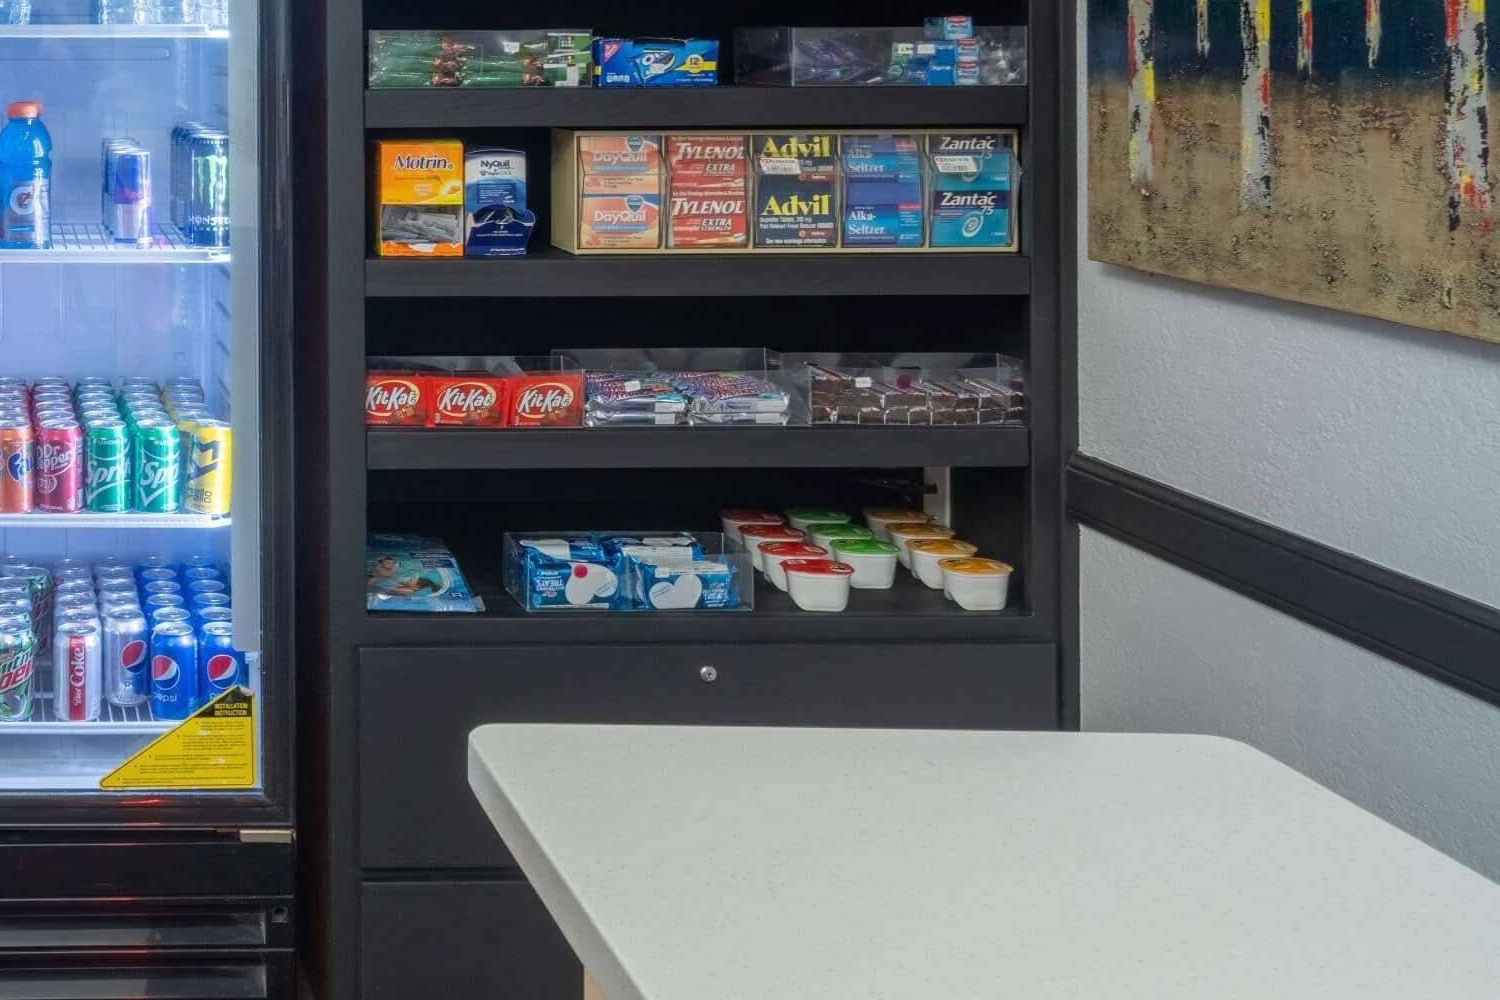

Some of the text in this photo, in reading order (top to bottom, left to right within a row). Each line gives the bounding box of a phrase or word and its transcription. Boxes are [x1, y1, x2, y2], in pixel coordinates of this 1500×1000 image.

[690, 57, 700, 66] 12
[760, 136, 831, 158] Advil
[940, 136, 996, 150] Zantac
[675, 143, 745, 161] TYLENOL
[394, 154, 448, 170] Motrin
[480, 160, 510, 169] NyQuil
[761, 194, 831, 216] Advil
[940, 192, 997, 206] Zantac
[671, 198, 744, 216] TYLENOL
[981, 206, 993, 215] 75
[595, 211, 646, 225] DayQuil
[848, 225, 885, 235] Seltzer
[69, 647, 85, 687] Coke
